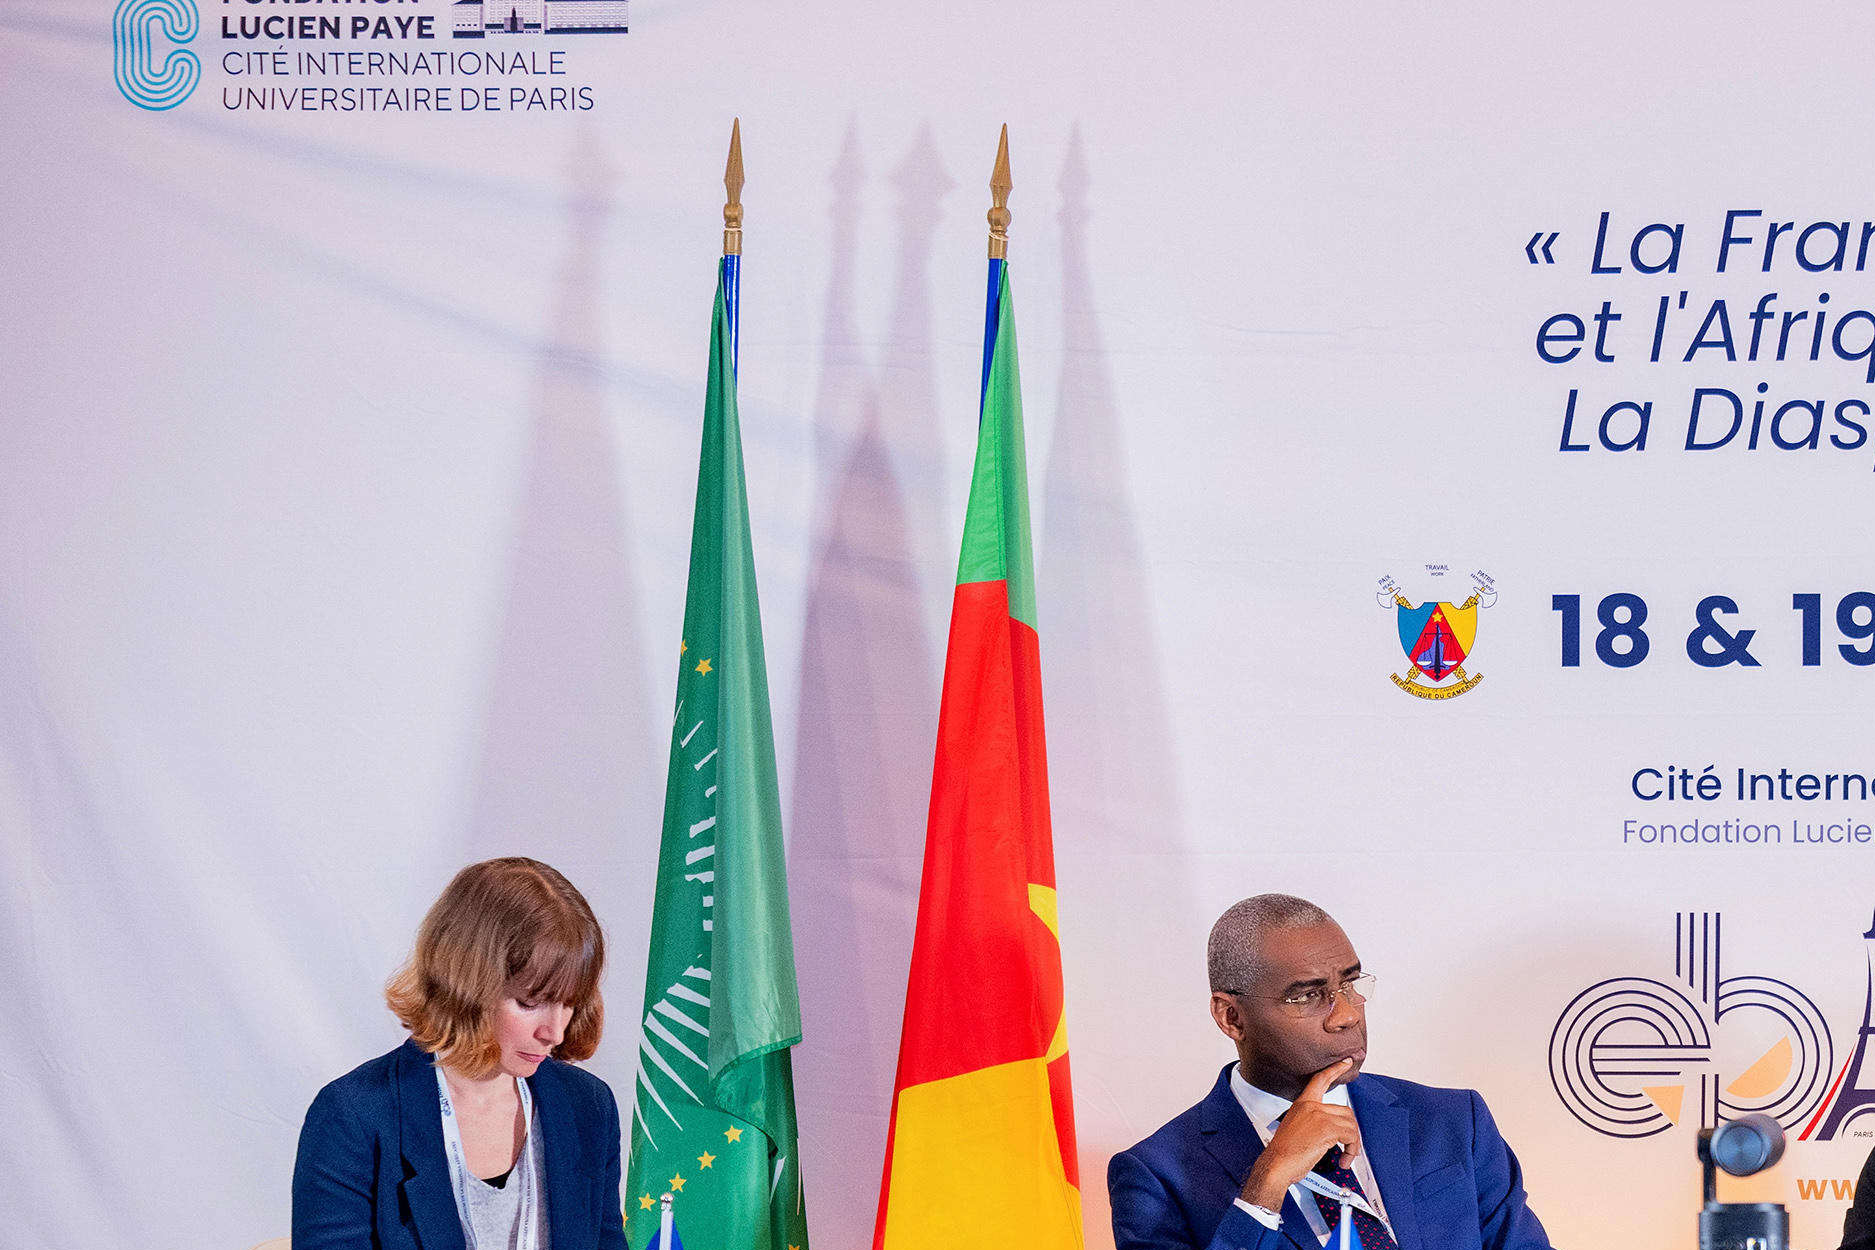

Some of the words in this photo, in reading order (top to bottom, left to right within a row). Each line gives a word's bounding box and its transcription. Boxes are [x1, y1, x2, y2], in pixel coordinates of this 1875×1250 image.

[222, 16, 340, 39] LUCIEN
[352, 16, 434, 39] PAYE
[223, 45, 289, 75] CITÉ
[298, 51, 565, 75] INTERNATIONALE
[223, 88, 452, 111] UNIVERSITAIRE
[461, 88, 500, 111] DE
[510, 87, 594, 110] PARIS
[1591, 212, 1684, 274] La
[1536, 302, 1622, 364] et
[1560, 389, 1653, 452] La
[1552, 593, 1650, 668] 18
[1686, 595, 1761, 667] &
[1632, 765, 1721, 801] Cité
[1624, 818, 1780, 843] Fondation
